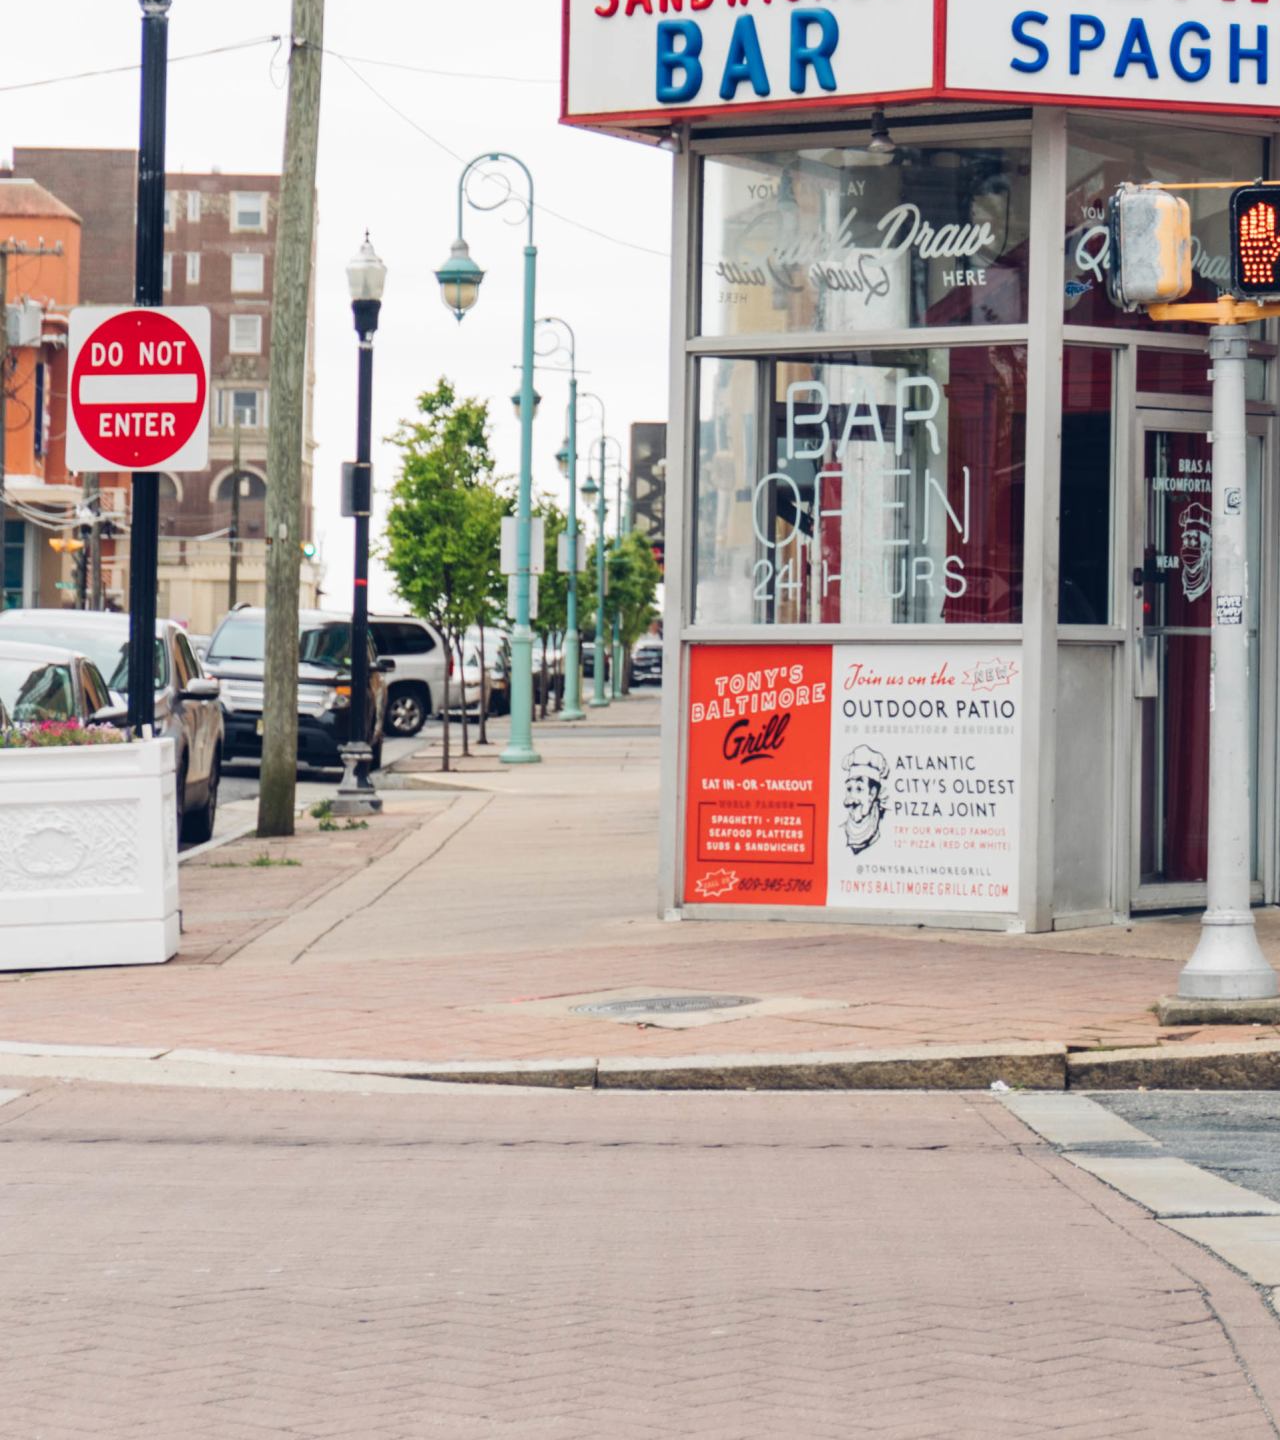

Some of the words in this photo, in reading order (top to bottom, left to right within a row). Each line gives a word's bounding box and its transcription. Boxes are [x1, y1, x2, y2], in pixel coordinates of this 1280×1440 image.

[655, 7, 839, 104] BAR
[1081, 206, 1105, 220] YOU
[877, 203, 995, 260] Draw
[943, 270, 987, 287] HERE
[91, 342, 124, 368] DO
[139, 341, 187, 366] NOT
[98, 412, 177, 438] ENTER
[787, 376, 940, 460] BAR
[1179, 459, 1203, 473] BRAS
[1152, 477, 1212, 492] UNCOMFORTA
[752, 466, 970, 549] OPEN
[1156, 556, 1179, 569] WEAR
[752, 558, 802, 600] 24
[715, 664, 803, 696] TONY'S
[844, 663, 882, 691] Join
[886, 675, 904, 686] us
[908, 675, 927, 686] on
[930, 662, 956, 686] the
[692, 683, 826, 723] BALTIMORE
[842, 700, 948, 718] OUTDOOR
[957, 700, 1015, 719] PATIO
[723, 713, 791, 761] Grill
[895, 756, 976, 771] ATLANTIC
[701, 778, 720, 790] EAT
[723, 779, 735, 790] IN
[894, 779, 946, 793] CITY'S
[953, 779, 1015, 794] OLDEST
[894, 802, 942, 817] PIZZA
[949, 802, 997, 817] JOINT
[711, 815, 763, 825] SPAGHETTI
[774, 816, 802, 826] PIZZA
[709, 828, 752, 838] SEAFOOD
[756, 829, 804, 839] PLATTERS
[706, 841, 731, 851] SUBS
[745, 842, 806, 853] SANDWICHES
